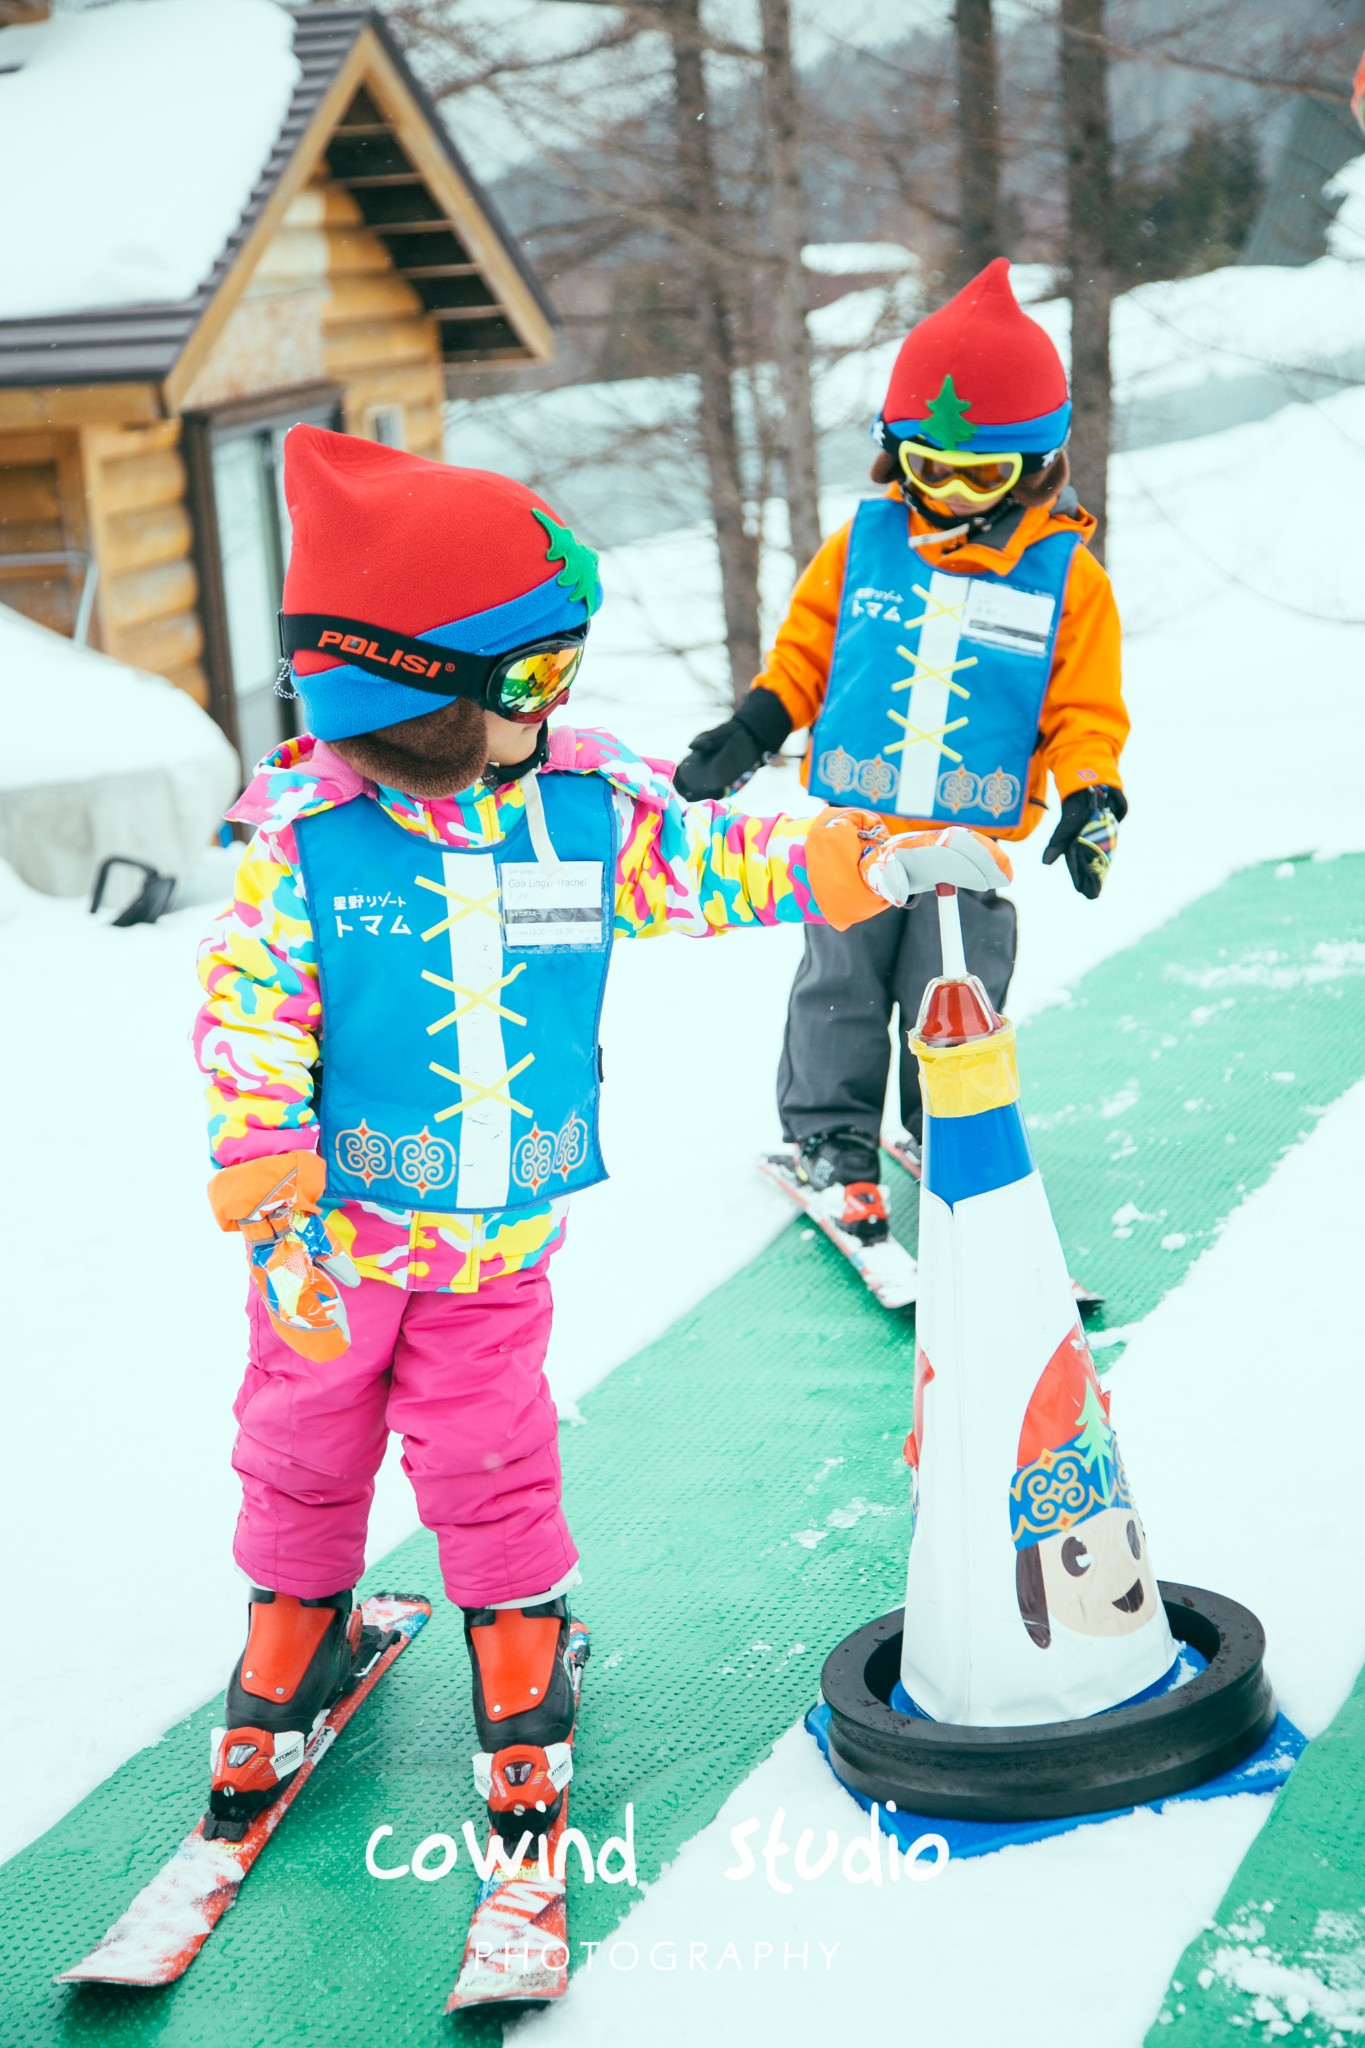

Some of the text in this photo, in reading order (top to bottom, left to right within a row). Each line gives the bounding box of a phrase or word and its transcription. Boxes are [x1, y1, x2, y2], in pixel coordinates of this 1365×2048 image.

[851, 599, 901, 623] トマム
[508, 878, 526, 888] Gao
[333, 891, 407, 911] 星野リゾート
[335, 915, 412, 938] トマム
[274, 1746, 299, 1764] ATOMIC
[551, 1757, 568, 1777] ATOMIC
